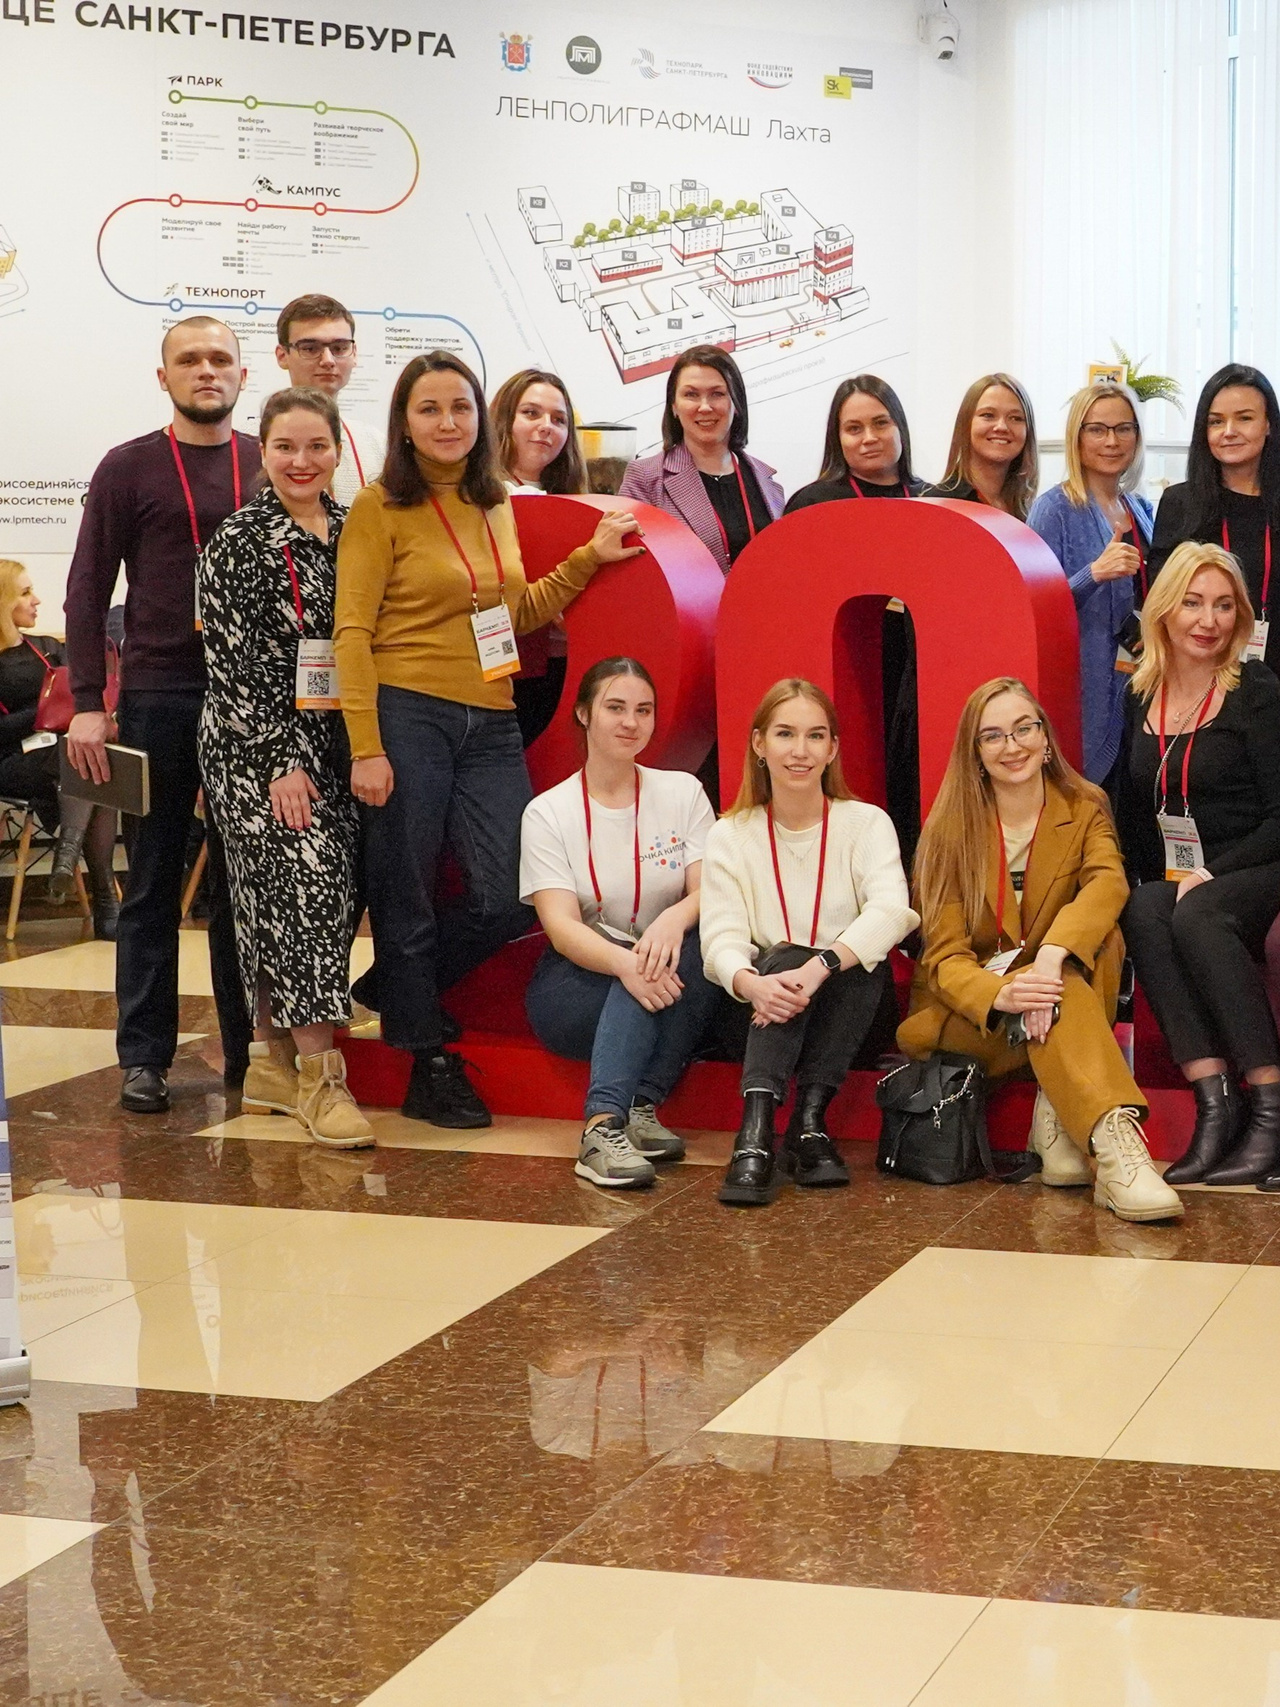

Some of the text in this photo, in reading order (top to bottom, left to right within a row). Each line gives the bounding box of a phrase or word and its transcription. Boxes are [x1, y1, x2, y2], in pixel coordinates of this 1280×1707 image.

[75, 0, 456, 59] САНКТ-ПЕТЕРБУРГА
[666, 60, 703, 69] ТЕХНОПАРК
[186, 75, 223, 87] ПАРК
[162, 111, 187, 119] Создай
[496, 95, 832, 143] ЛЕНПОЛИГРАФМАШ Лахта
[314, 122, 345, 130] Развивай
[314, 131, 358, 139] воображение
[286, 184, 341, 198] КАМПУС
[162, 217, 204, 226] Моделируй
[312, 225, 340, 233] Запусти
[185, 286, 267, 299] ТЕХНОПОРТ
